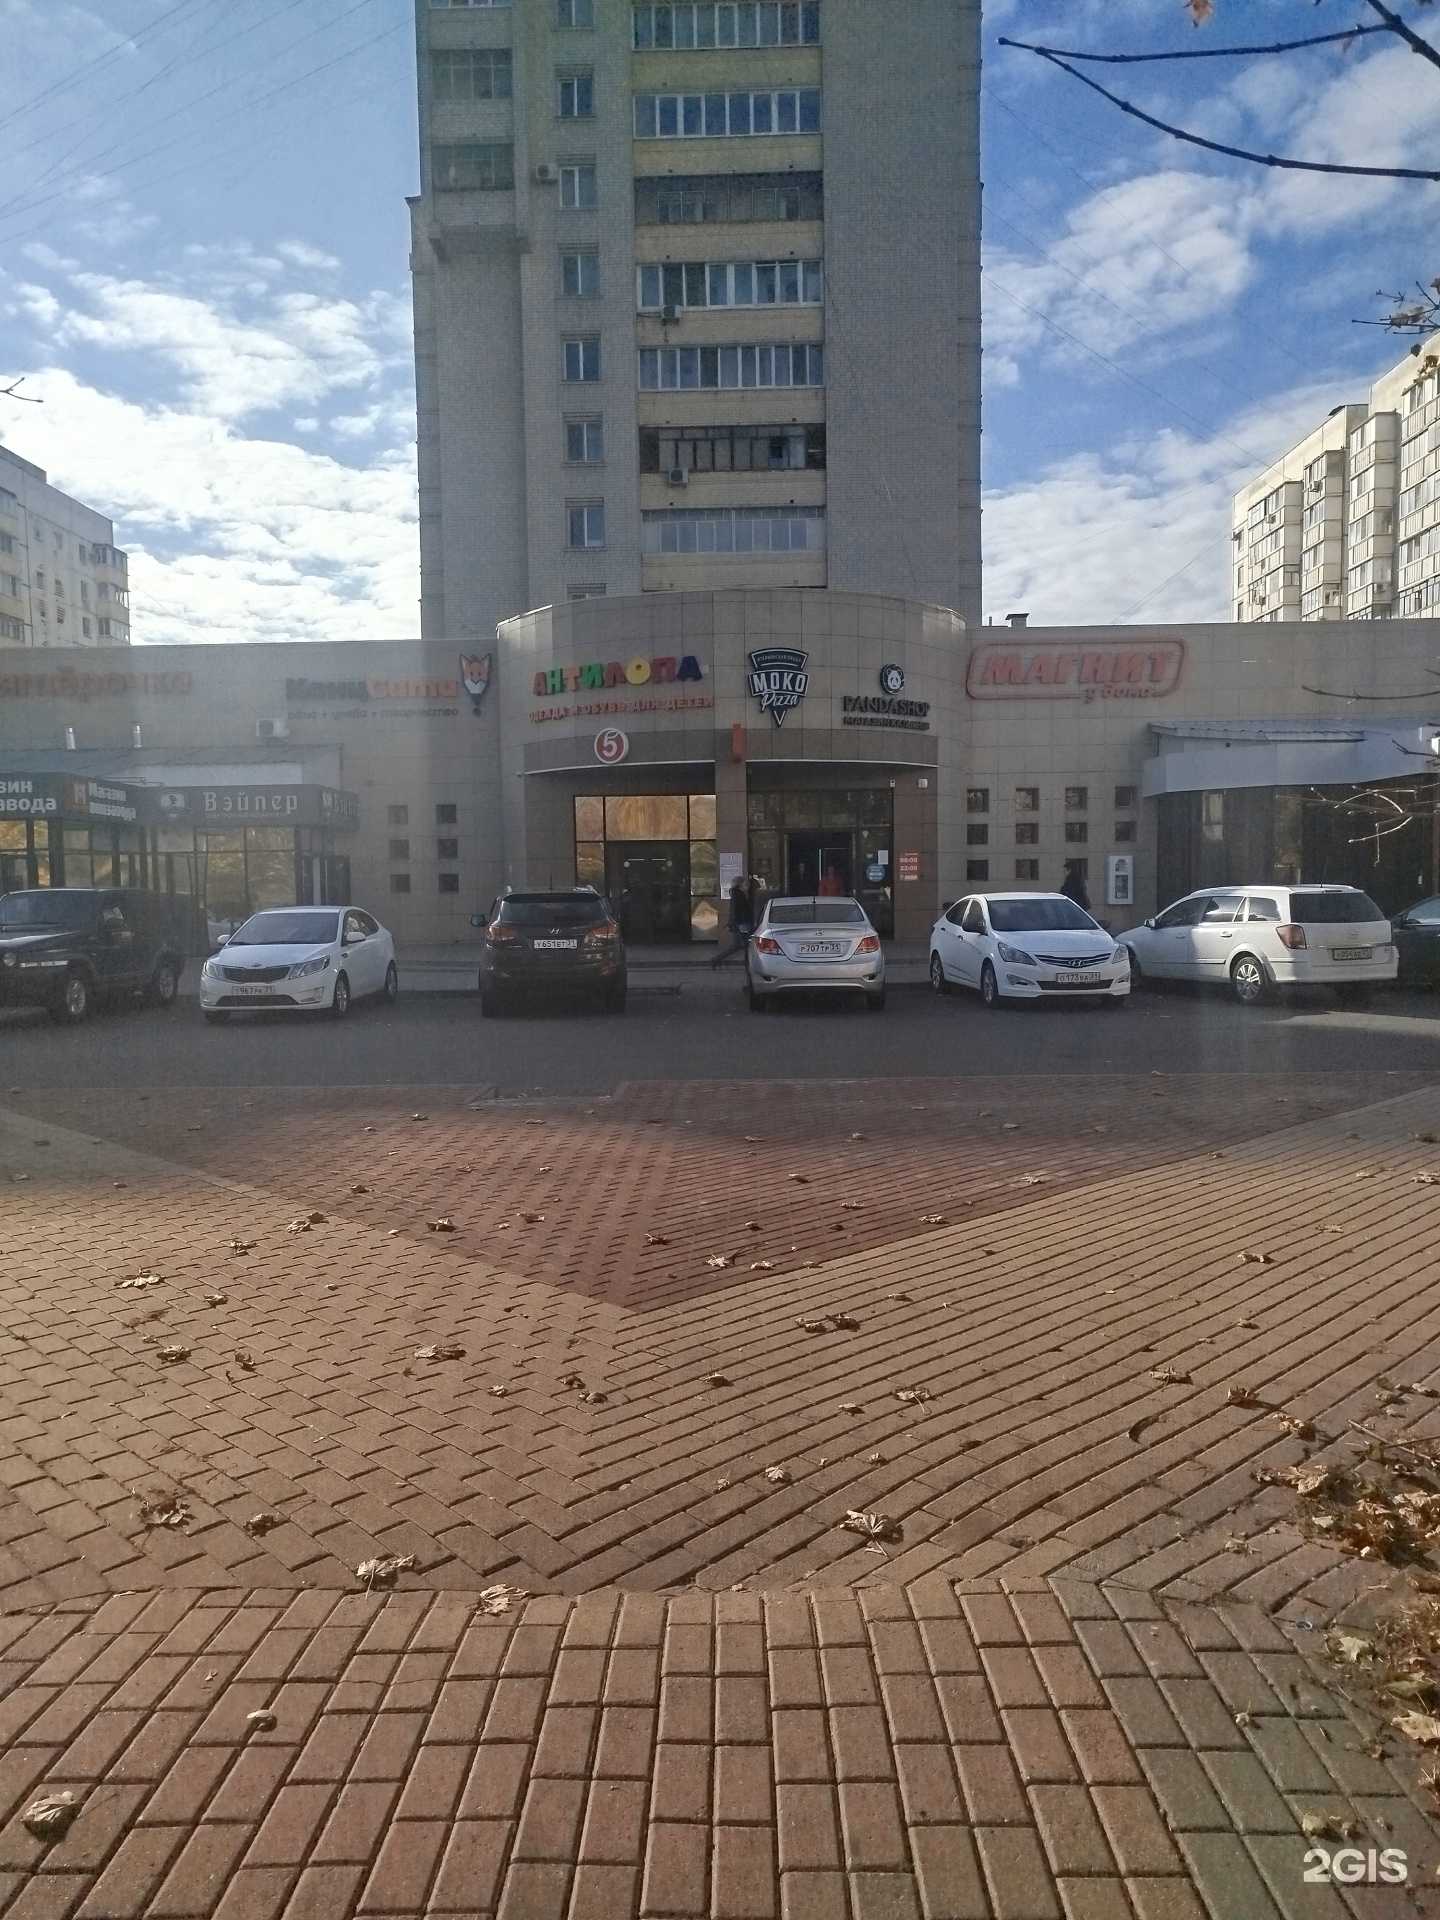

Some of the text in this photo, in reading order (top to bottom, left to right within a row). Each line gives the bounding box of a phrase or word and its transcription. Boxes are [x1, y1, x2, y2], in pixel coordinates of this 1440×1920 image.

[532, 655, 704, 696] АНТИЛОПА
[981, 653, 1168, 685] МАГНИТ
[761, 689, 799, 711] Pizza
[203, 791, 298, 815] Вэйпер
